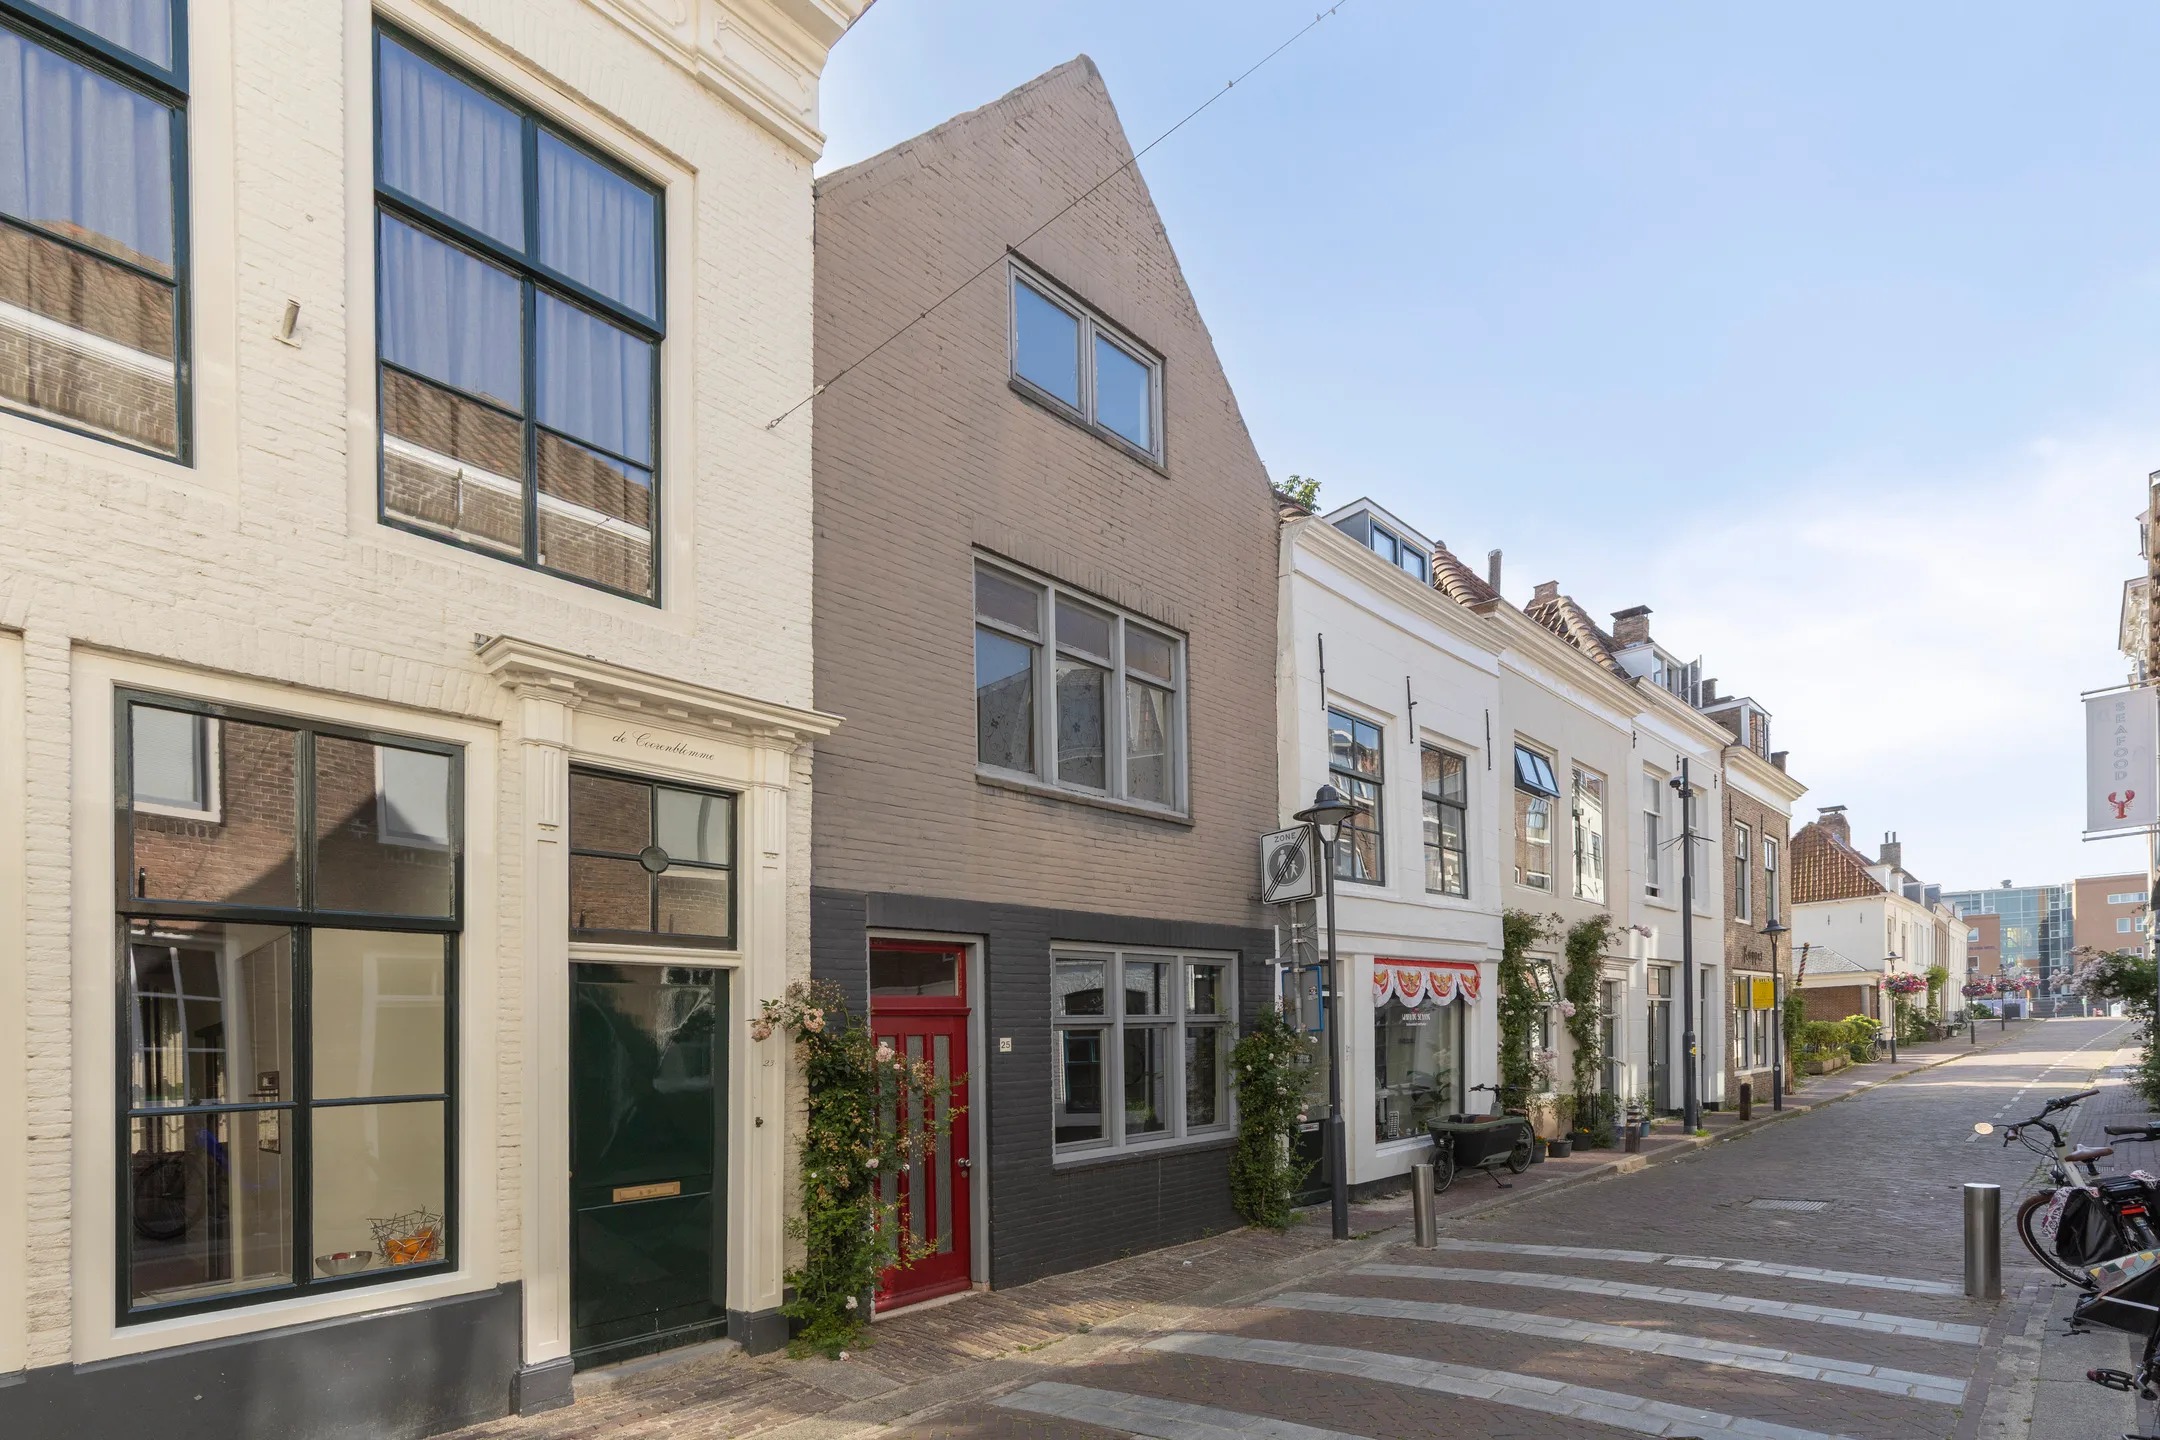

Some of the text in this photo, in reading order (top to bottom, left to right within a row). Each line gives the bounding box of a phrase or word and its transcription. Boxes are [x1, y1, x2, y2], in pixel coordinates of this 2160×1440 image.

[612, 731, 627, 743] de
[2113, 701, 2129, 781] SEAFOOD
[1274, 832, 1296, 843] ZONE
[1000, 1041, 1011, 1049] 25
